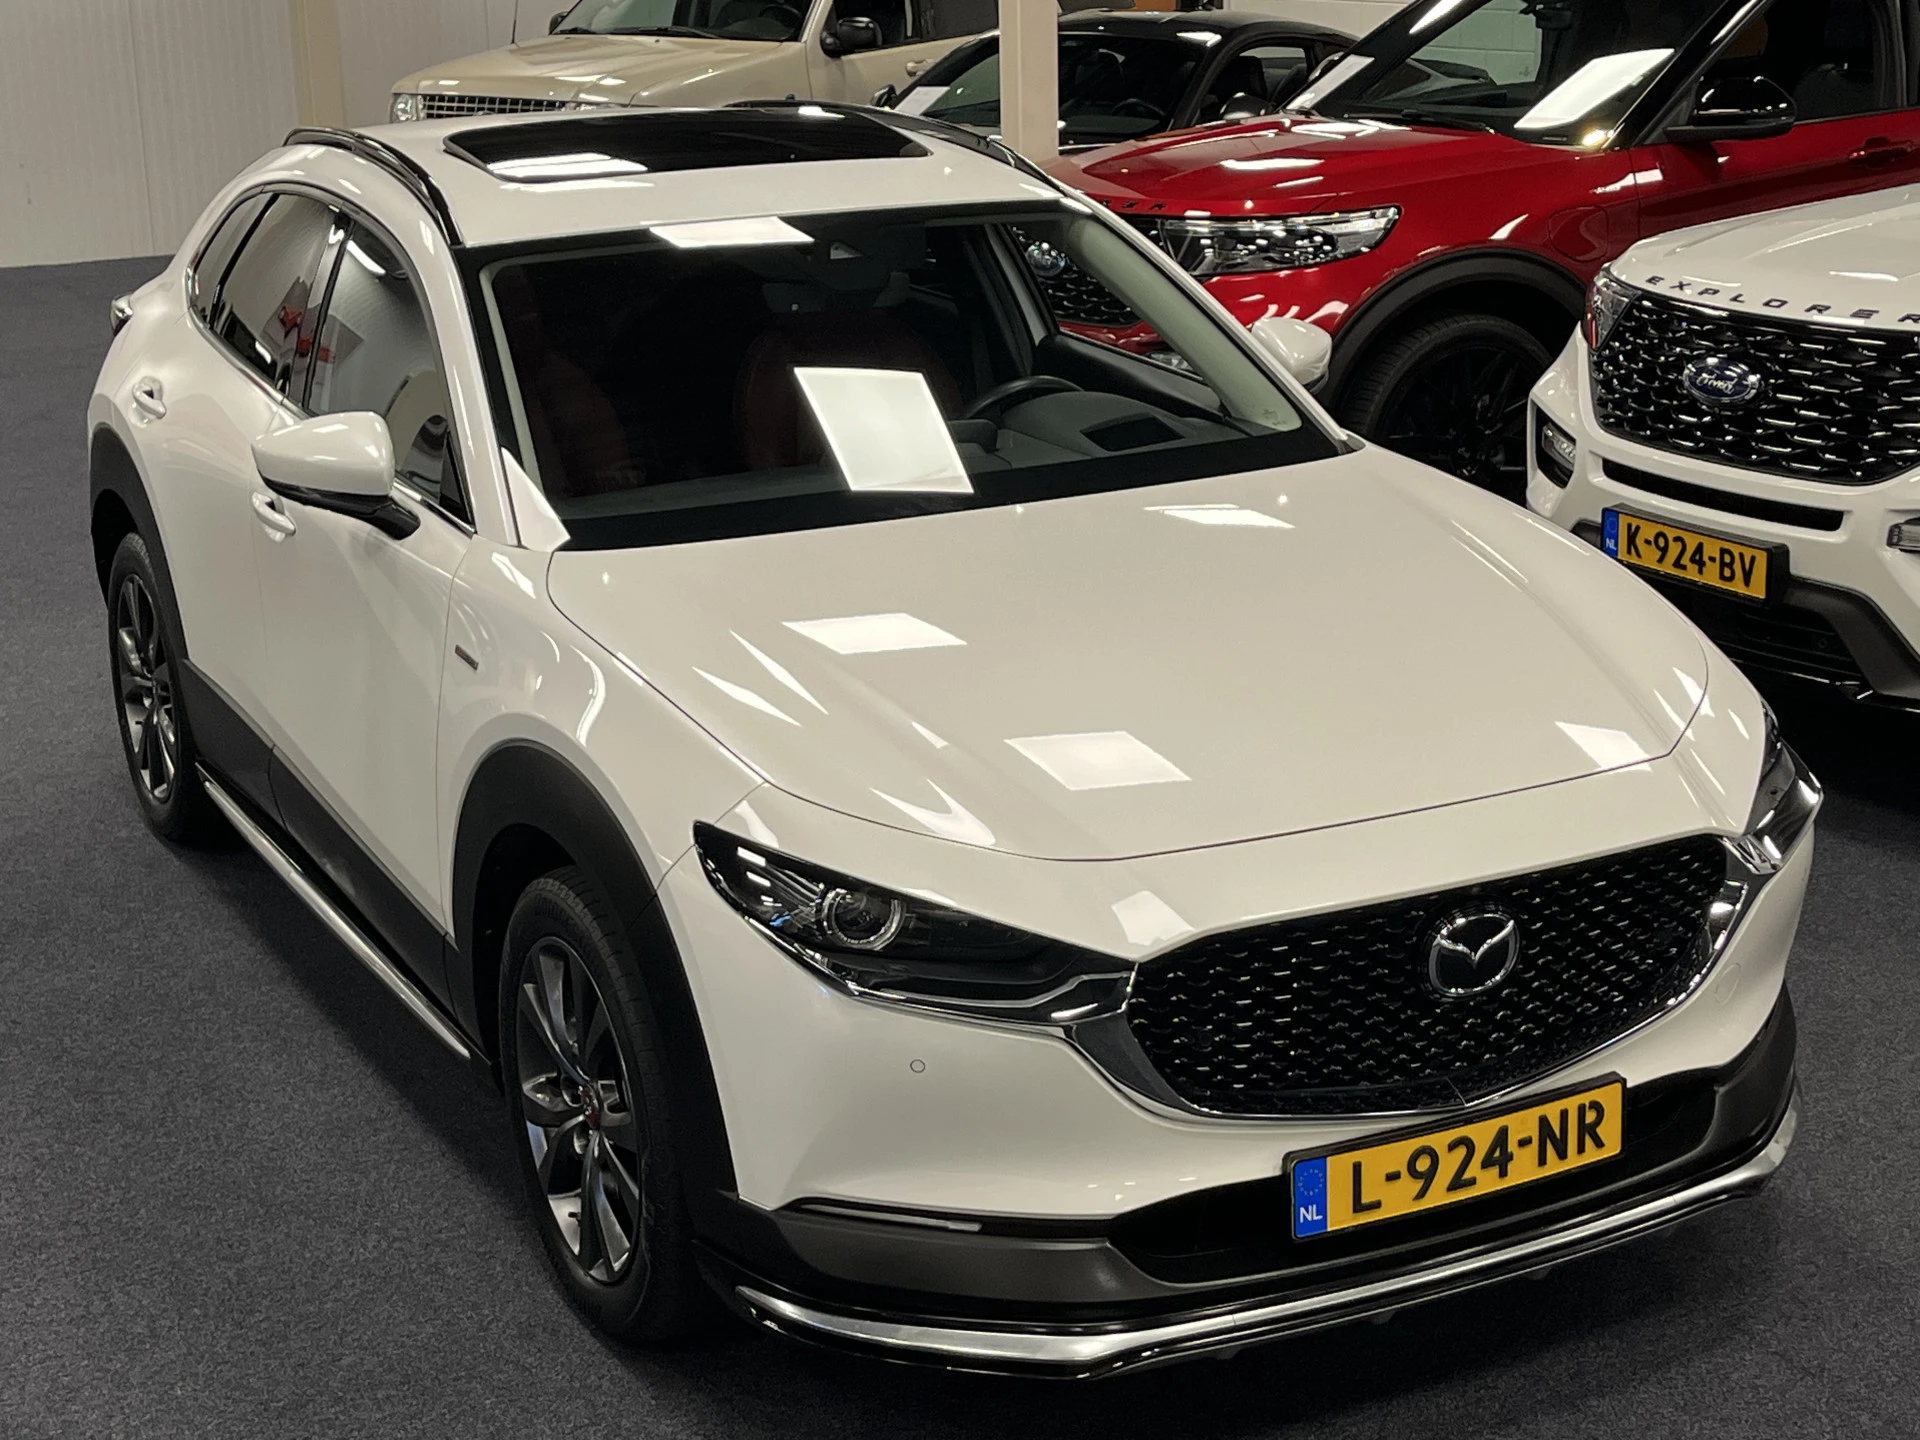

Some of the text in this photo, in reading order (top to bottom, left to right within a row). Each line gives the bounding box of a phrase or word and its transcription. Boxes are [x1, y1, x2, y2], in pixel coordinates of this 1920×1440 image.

[1645, 275, 1920, 324] EXPLORER
[1605, 537, 1617, 551] NL
[1626, 522, 1756, 588] K-924-BV
[1352, 1100, 1606, 1214] L-924-NR
[1299, 1204, 1323, 1223] NL
